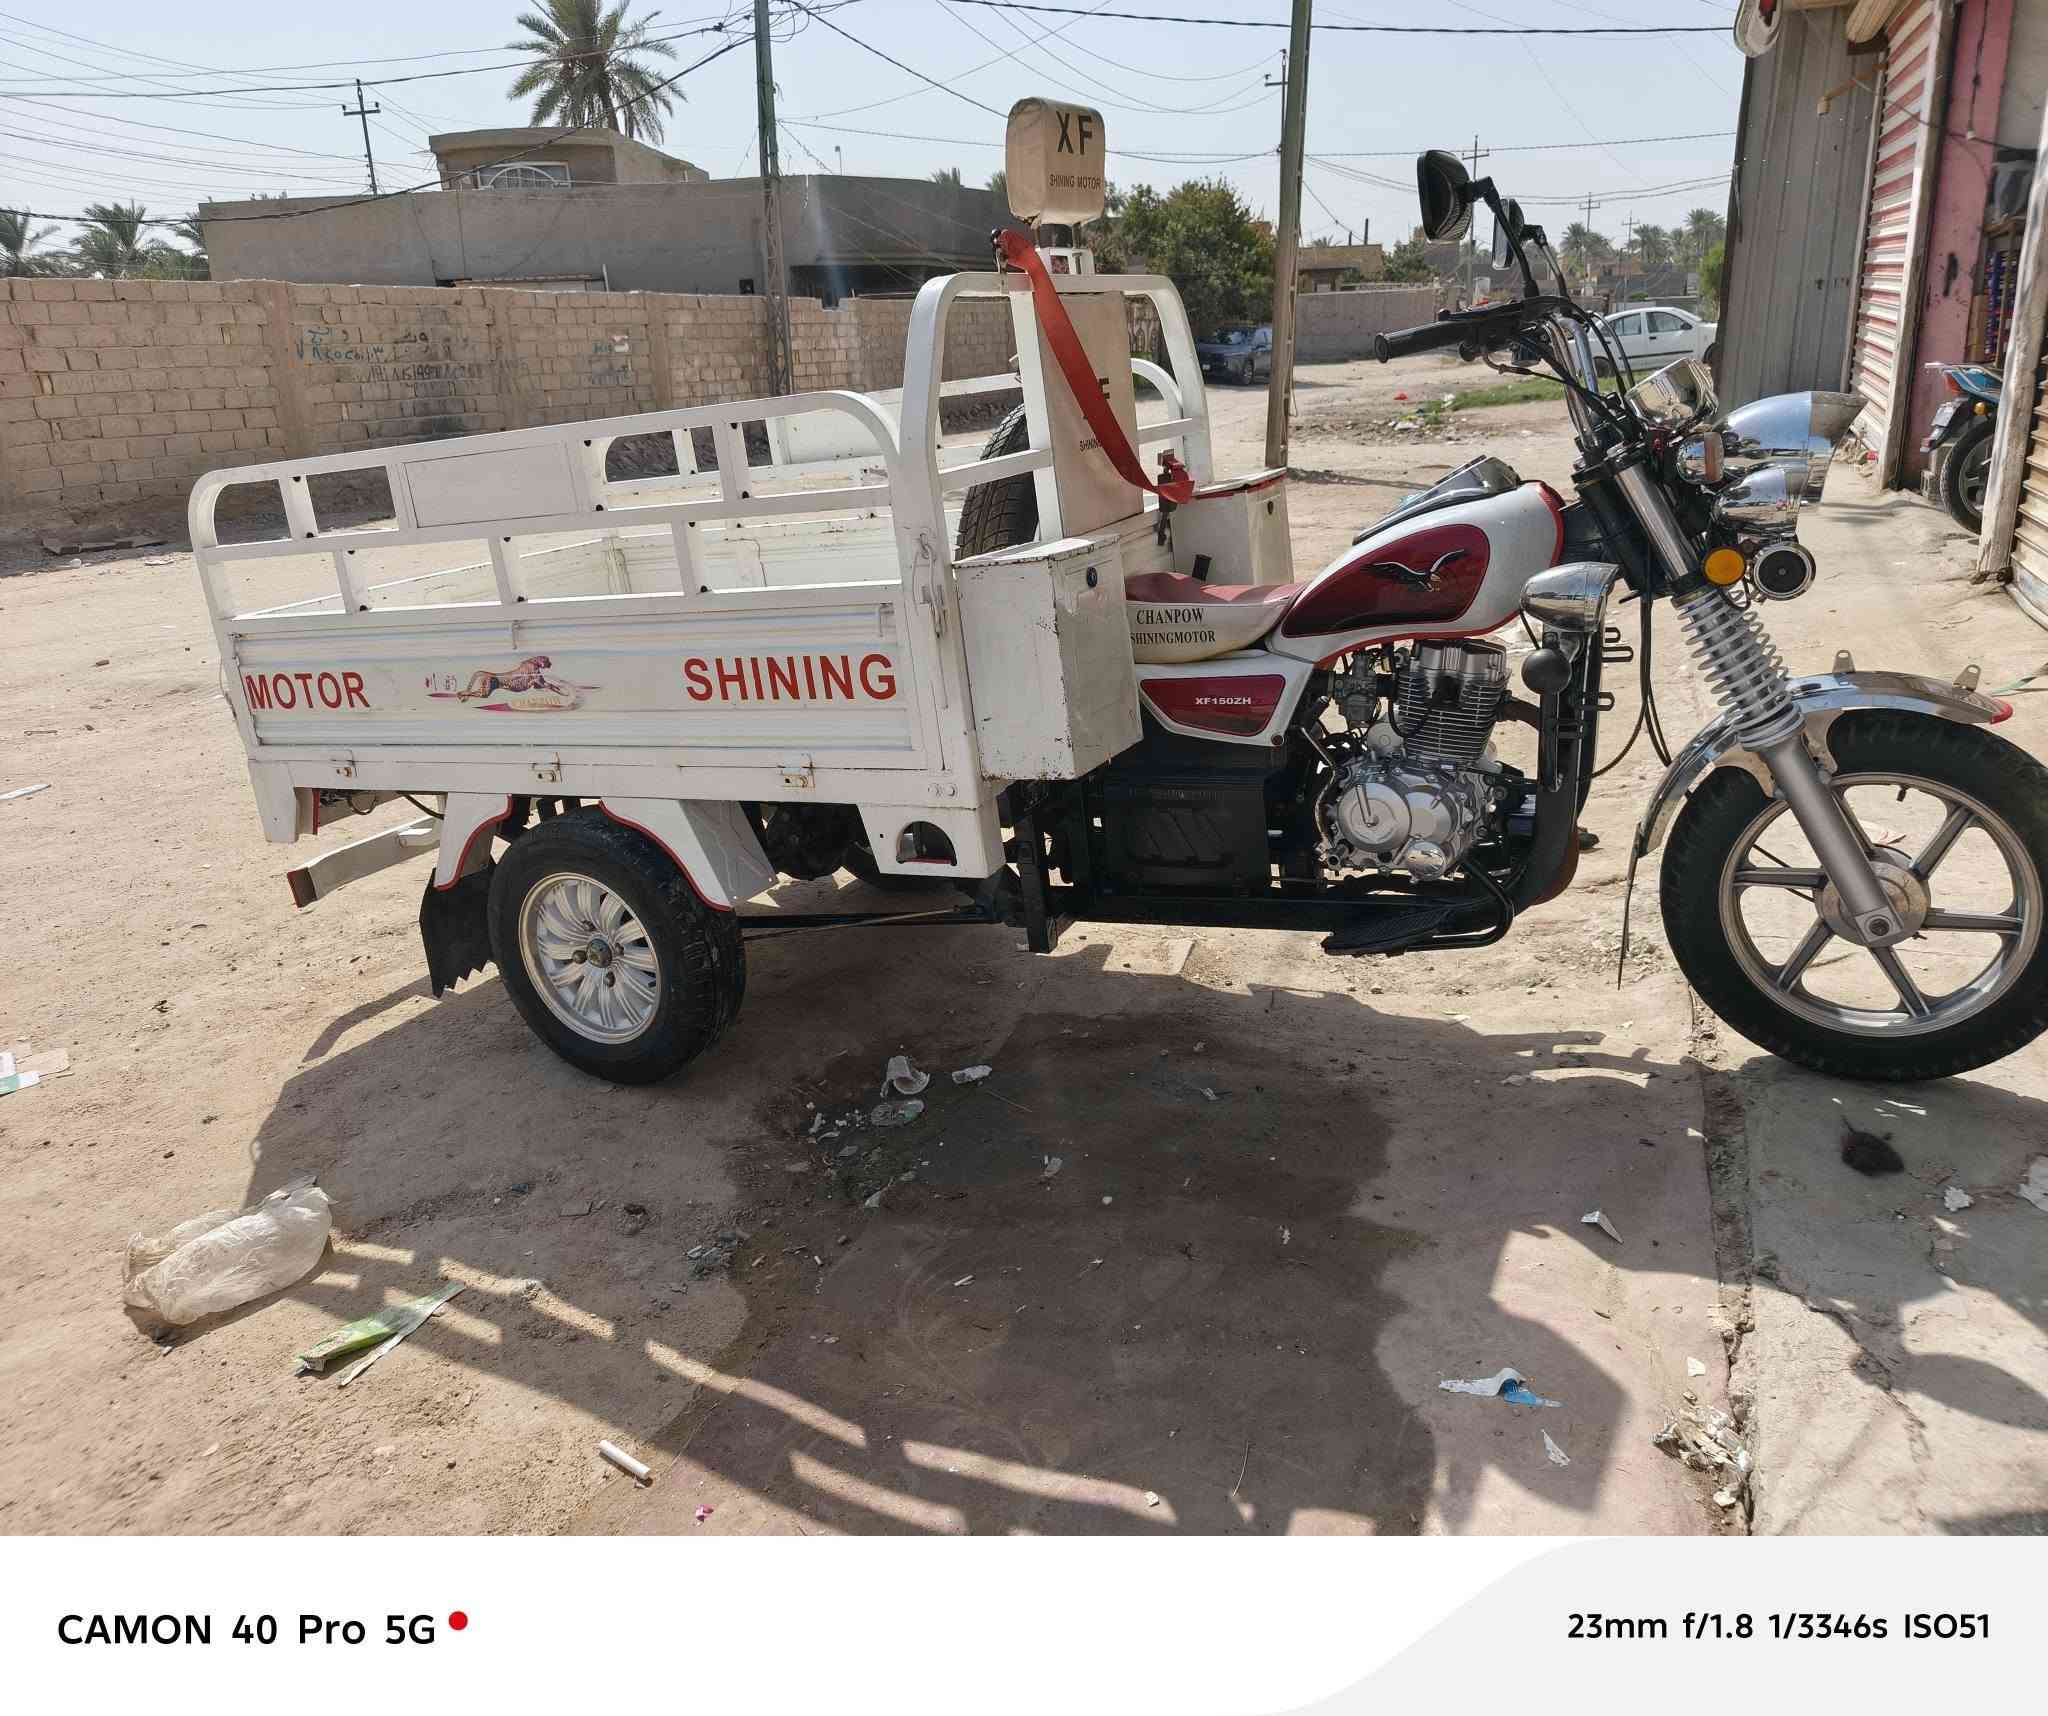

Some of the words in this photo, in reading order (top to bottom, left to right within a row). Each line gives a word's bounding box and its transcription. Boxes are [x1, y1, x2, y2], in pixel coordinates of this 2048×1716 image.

[1056, 110, 1093, 155] XF
[1049, 174, 1075, 188] SHINING
[1077, 175, 1102, 190] MOTOR
[1136, 607, 1205, 625] CHANPOW
[245, 671, 370, 709] MOTOR
[684, 653, 897, 701] SHINING
[1195, 697, 1252, 705] XF150ZH
